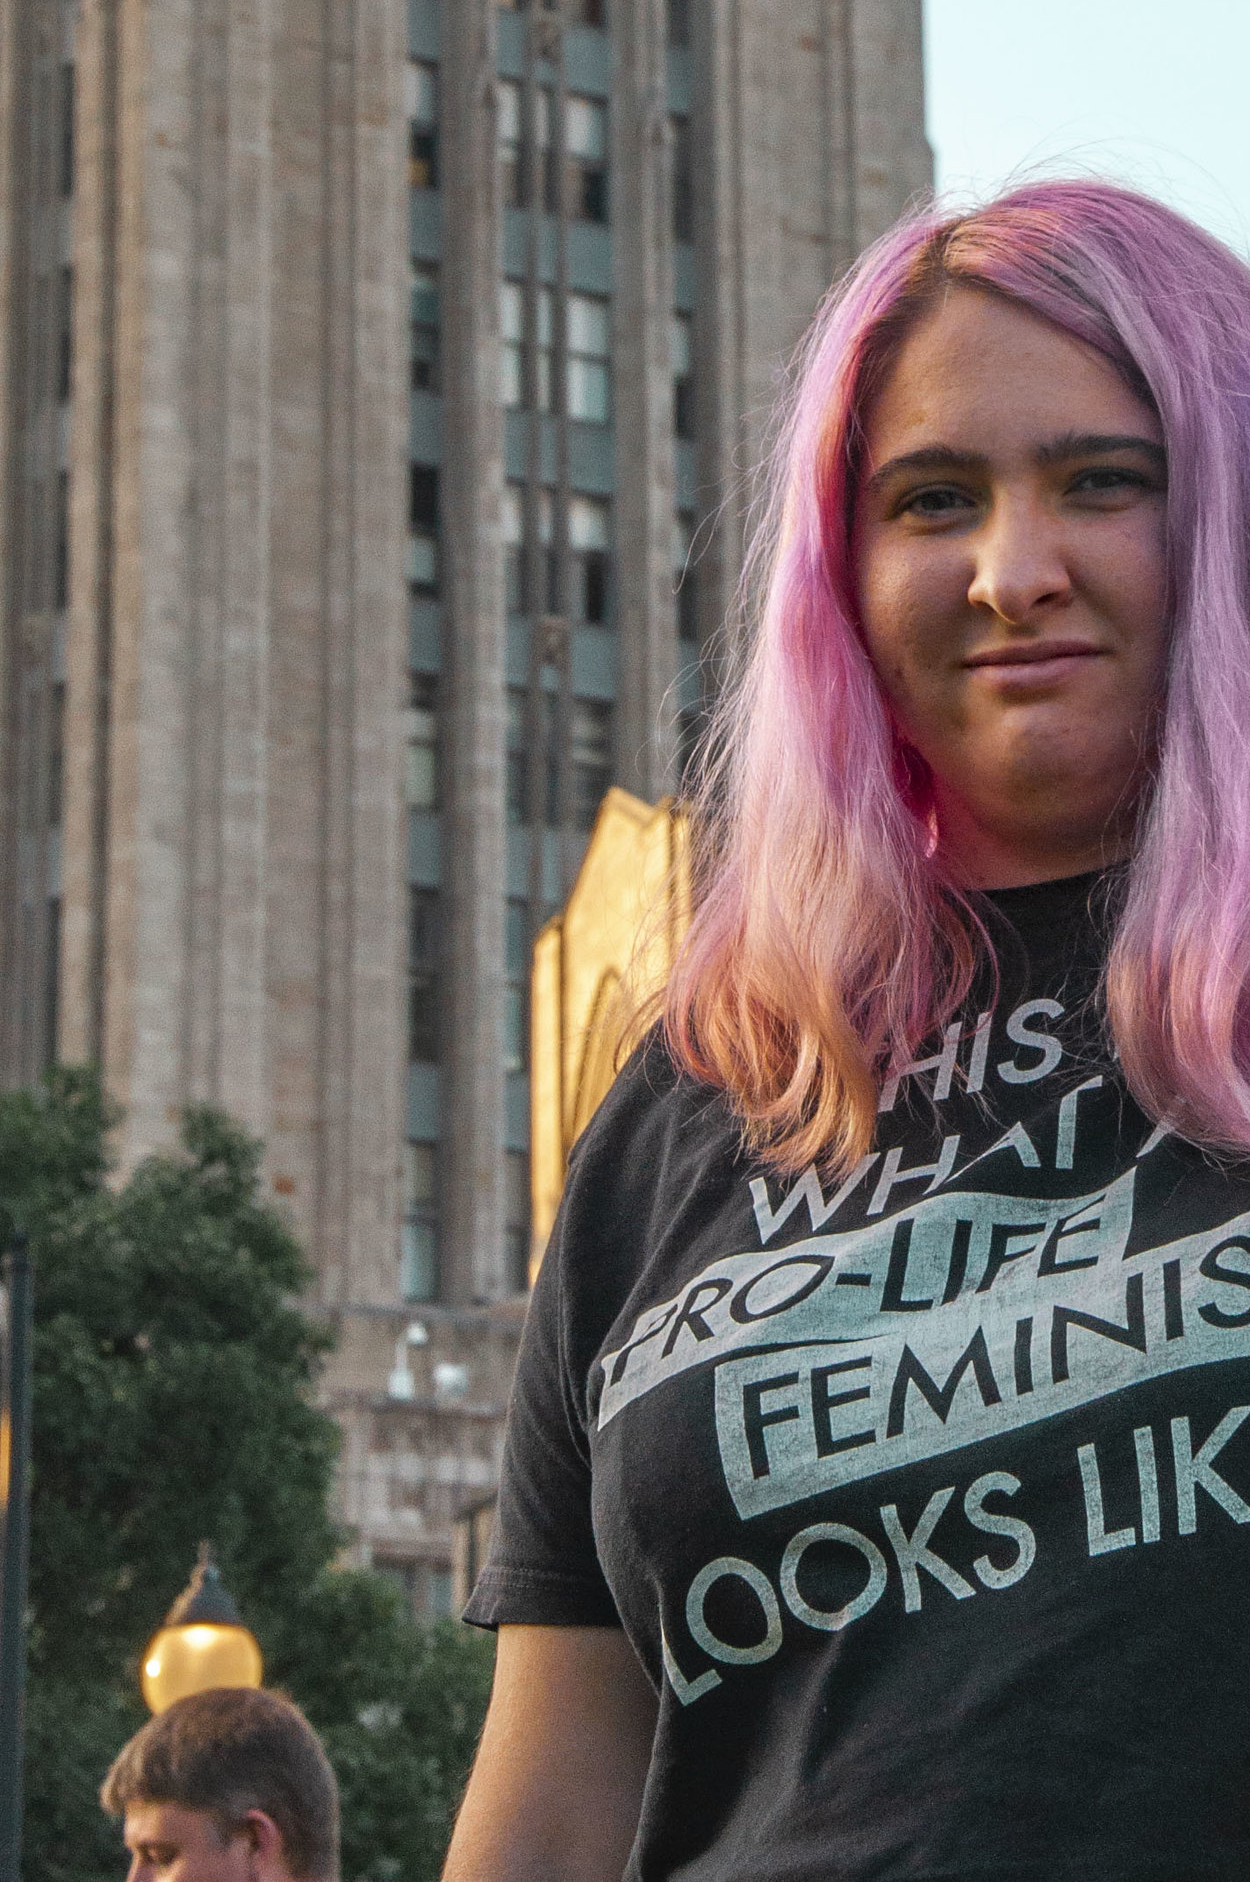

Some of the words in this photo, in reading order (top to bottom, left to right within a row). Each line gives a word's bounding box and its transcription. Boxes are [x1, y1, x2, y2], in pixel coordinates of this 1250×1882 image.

[875, 997, 1066, 1114] HIS
[749, 1074, 1103, 1245] WHAT
[608, 1190, 1106, 1389] PRO-LIFE
[661, 1471, 1037, 1706] LOOKS
